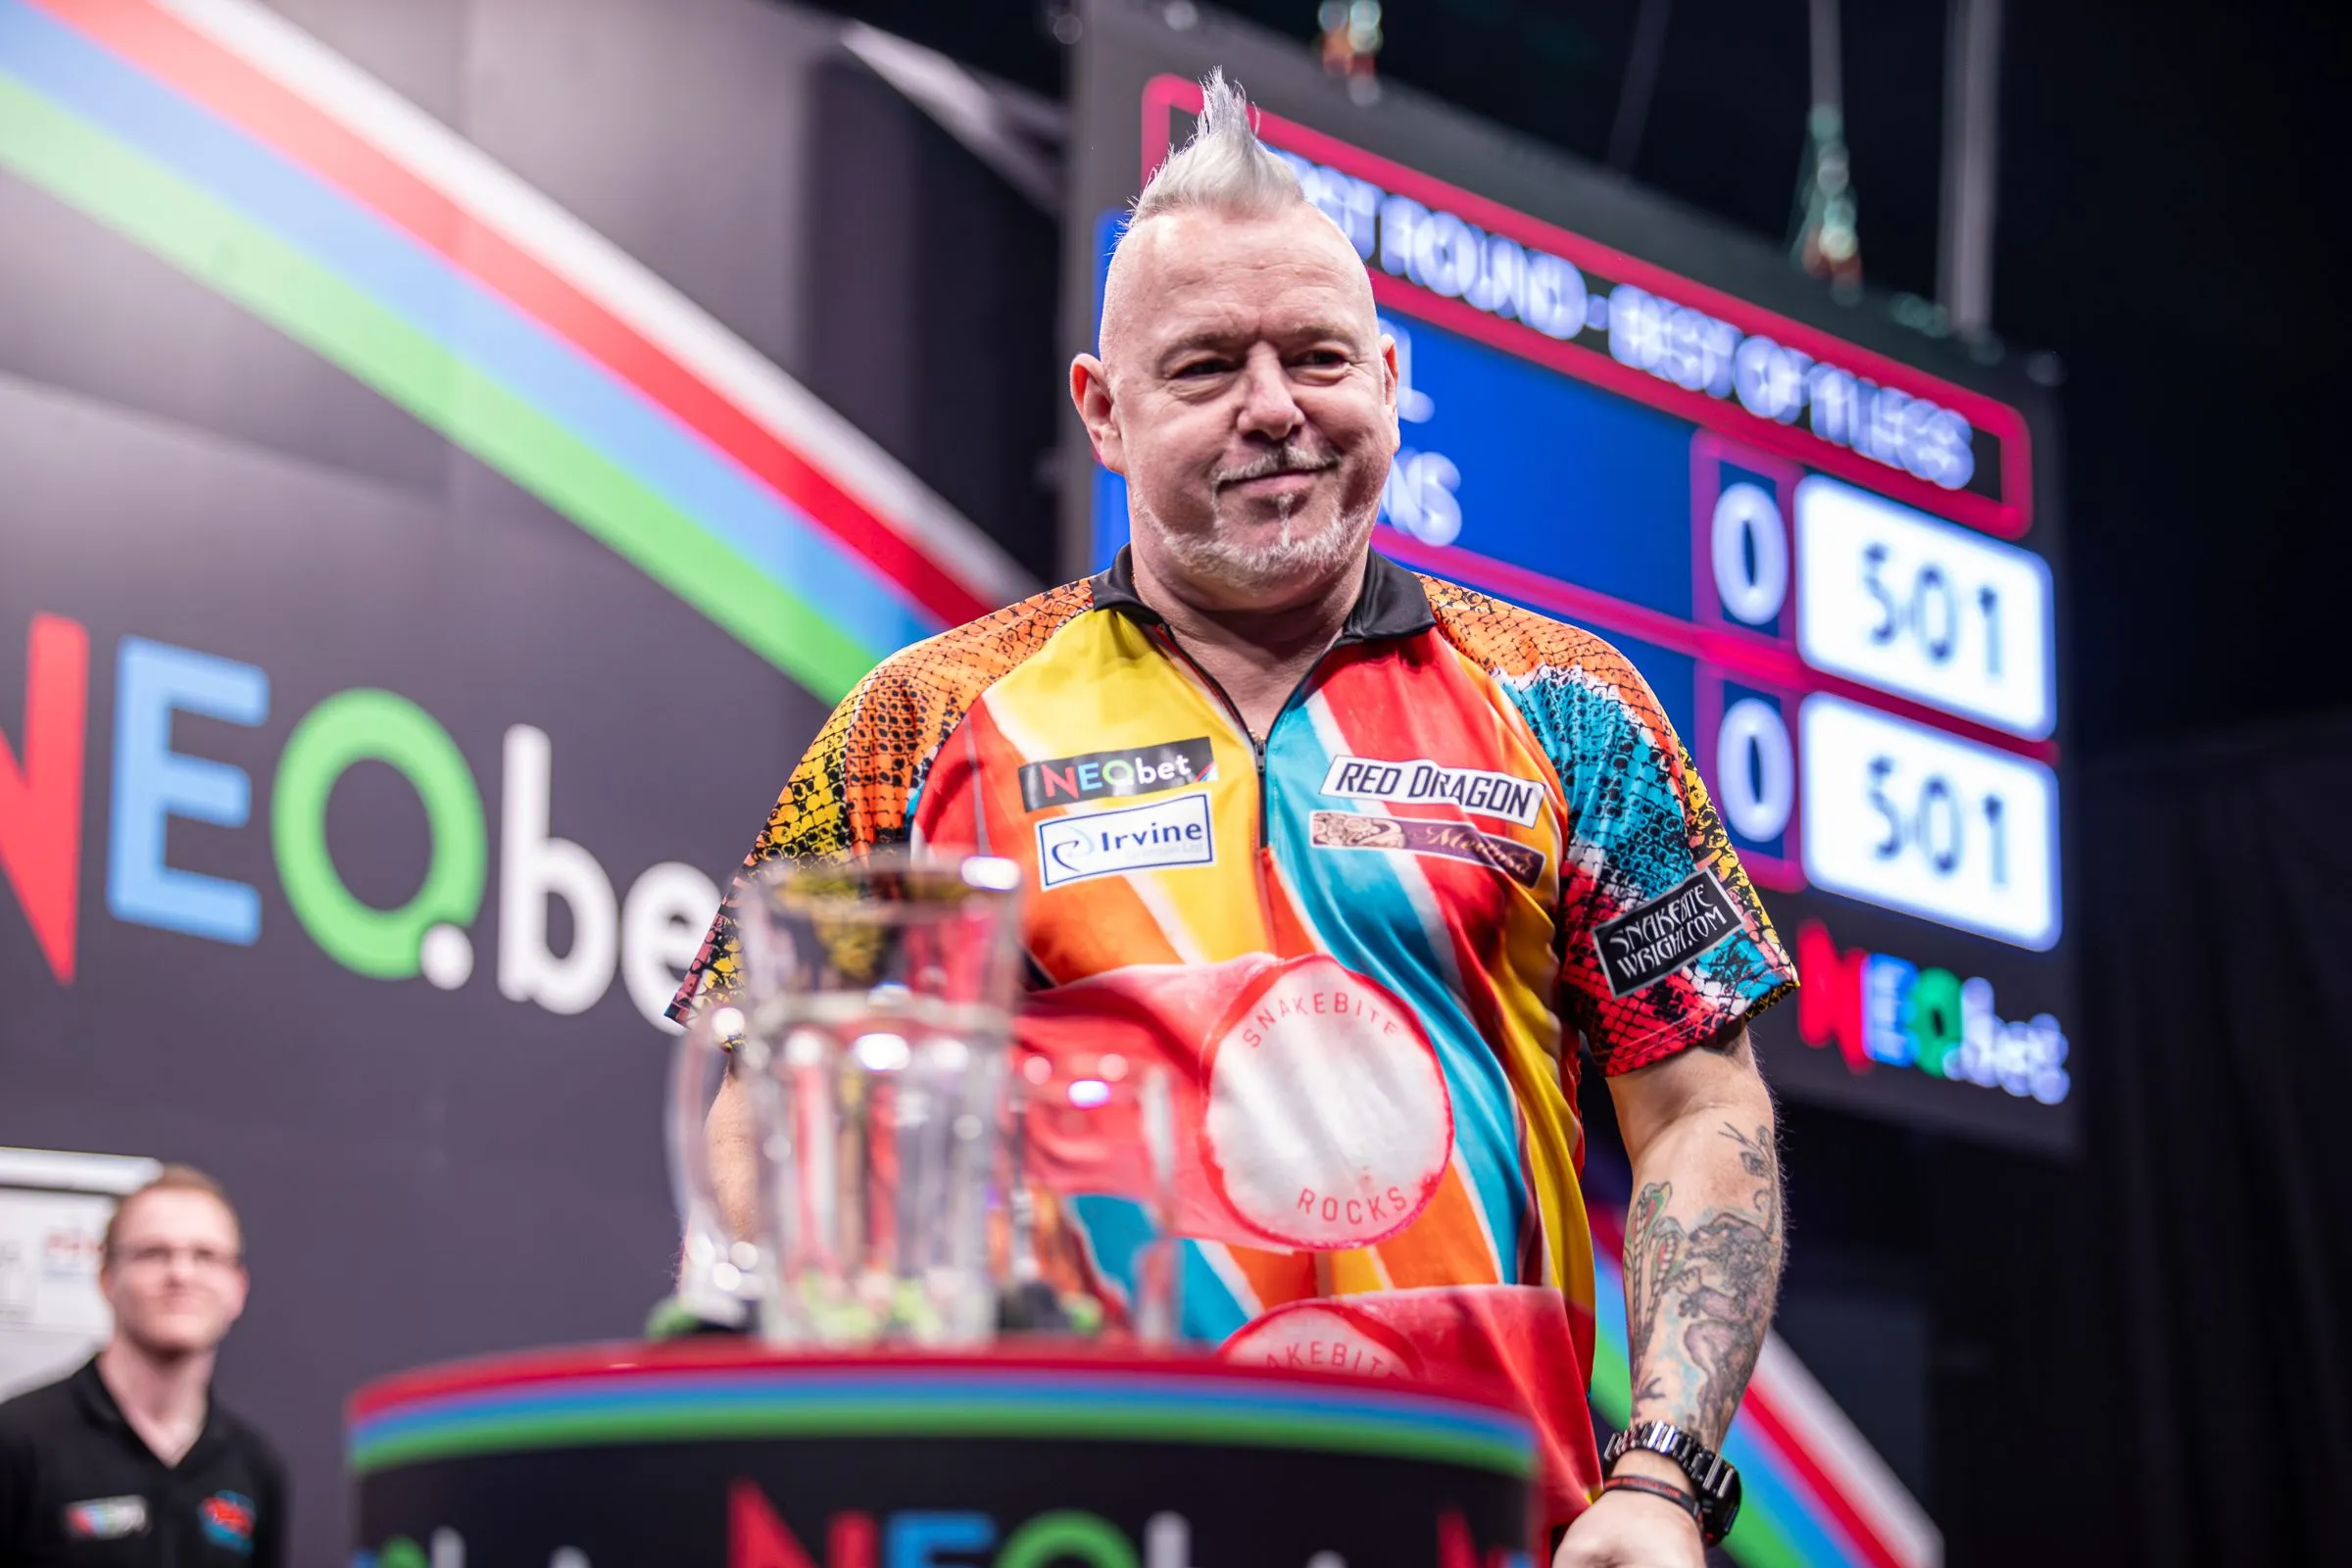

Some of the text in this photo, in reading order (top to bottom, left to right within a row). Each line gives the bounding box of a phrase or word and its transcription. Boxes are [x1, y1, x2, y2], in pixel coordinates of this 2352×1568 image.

[1712, 483, 1788, 624] 0
[1863, 542, 2005, 677] 501
[1336, 762, 1533, 818] RED DRAGON
[1717, 698, 1794, 842] 0
[0, 611, 722, 1037] NEO.be
[1101, 822, 1202, 852] Irvine
[1867, 755, 2010, 886] 501
[1609, 884, 1714, 952] SNAKEBITE
[1617, 906, 1727, 979] WRIGHT.COM
[1243, 991, 1398, 1049] SNAKEBITE
[1297, 1186, 1407, 1225] ROCKS
[1265, 1340, 1384, 1375] AKEBIT
